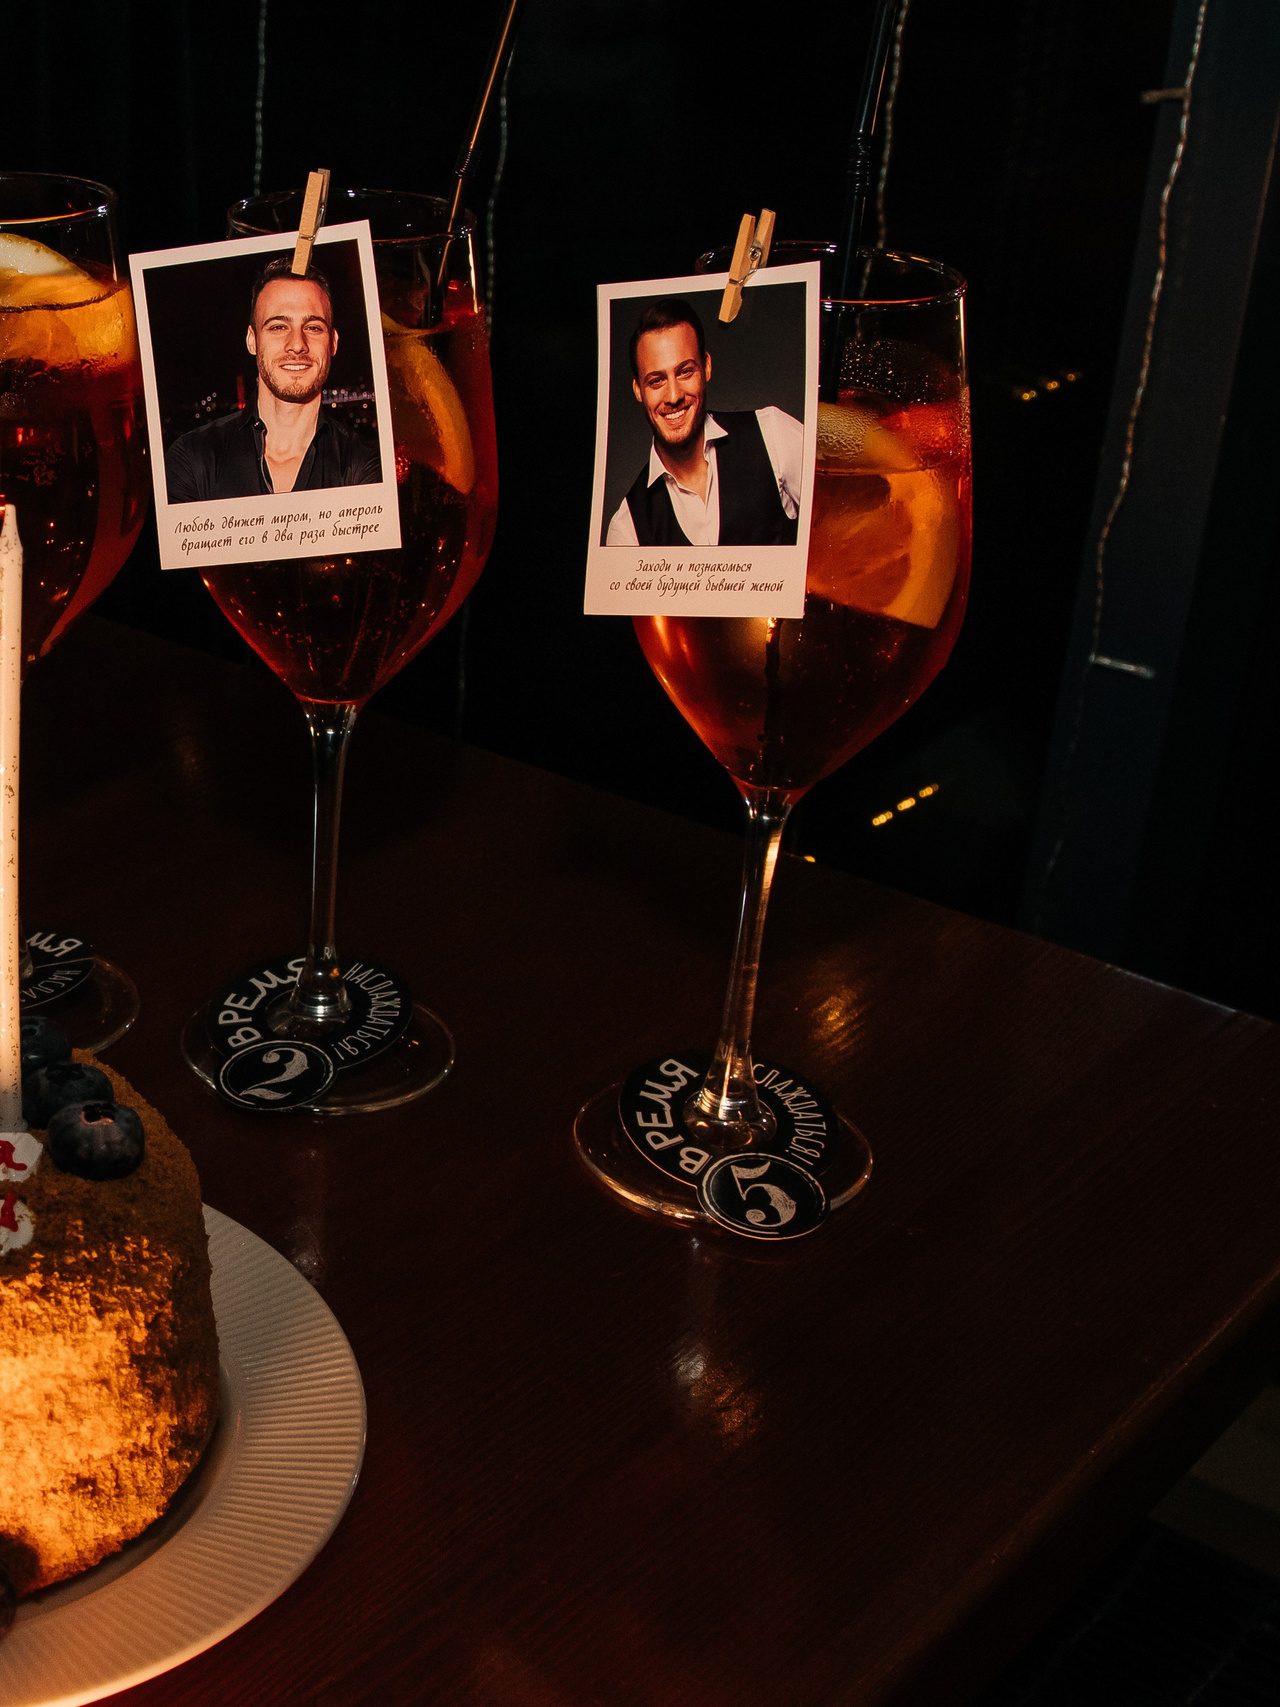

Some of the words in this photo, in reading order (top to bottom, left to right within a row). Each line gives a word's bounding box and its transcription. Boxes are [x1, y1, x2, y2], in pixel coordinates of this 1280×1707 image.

[175, 516, 215, 534] Любовь
[221, 515, 264, 530] движет
[271, 513, 312, 528] миром,
[319, 510, 332, 519] но
[338, 504, 383, 521] апероль
[181, 536, 232, 555] вращает
[239, 535, 255, 545] его
[261, 531, 268, 544] в
[274, 529, 293, 543] два
[300, 530, 325, 545] раза
[332, 520, 380, 539] быстрее
[610, 582, 620, 591] со
[626, 578, 653, 591] своей
[657, 575, 701, 597] будущей
[706, 575, 746, 592] бывшей
[750, 580, 785, 592] женой
[636, 559, 672, 572] Заходи
[677, 563, 683, 572] и
[688, 563, 752, 578] познакомься
[331, 963, 402, 1061] НАСЛАЖДАТЬСЯ!
[239, 1047, 309, 1101] 2
[636, 1058, 713, 1175] ВРЕМЯ
[753, 1064, 827, 1166] СЛАЖДАТЬСЯ!
[731, 1161, 797, 1228] 5
